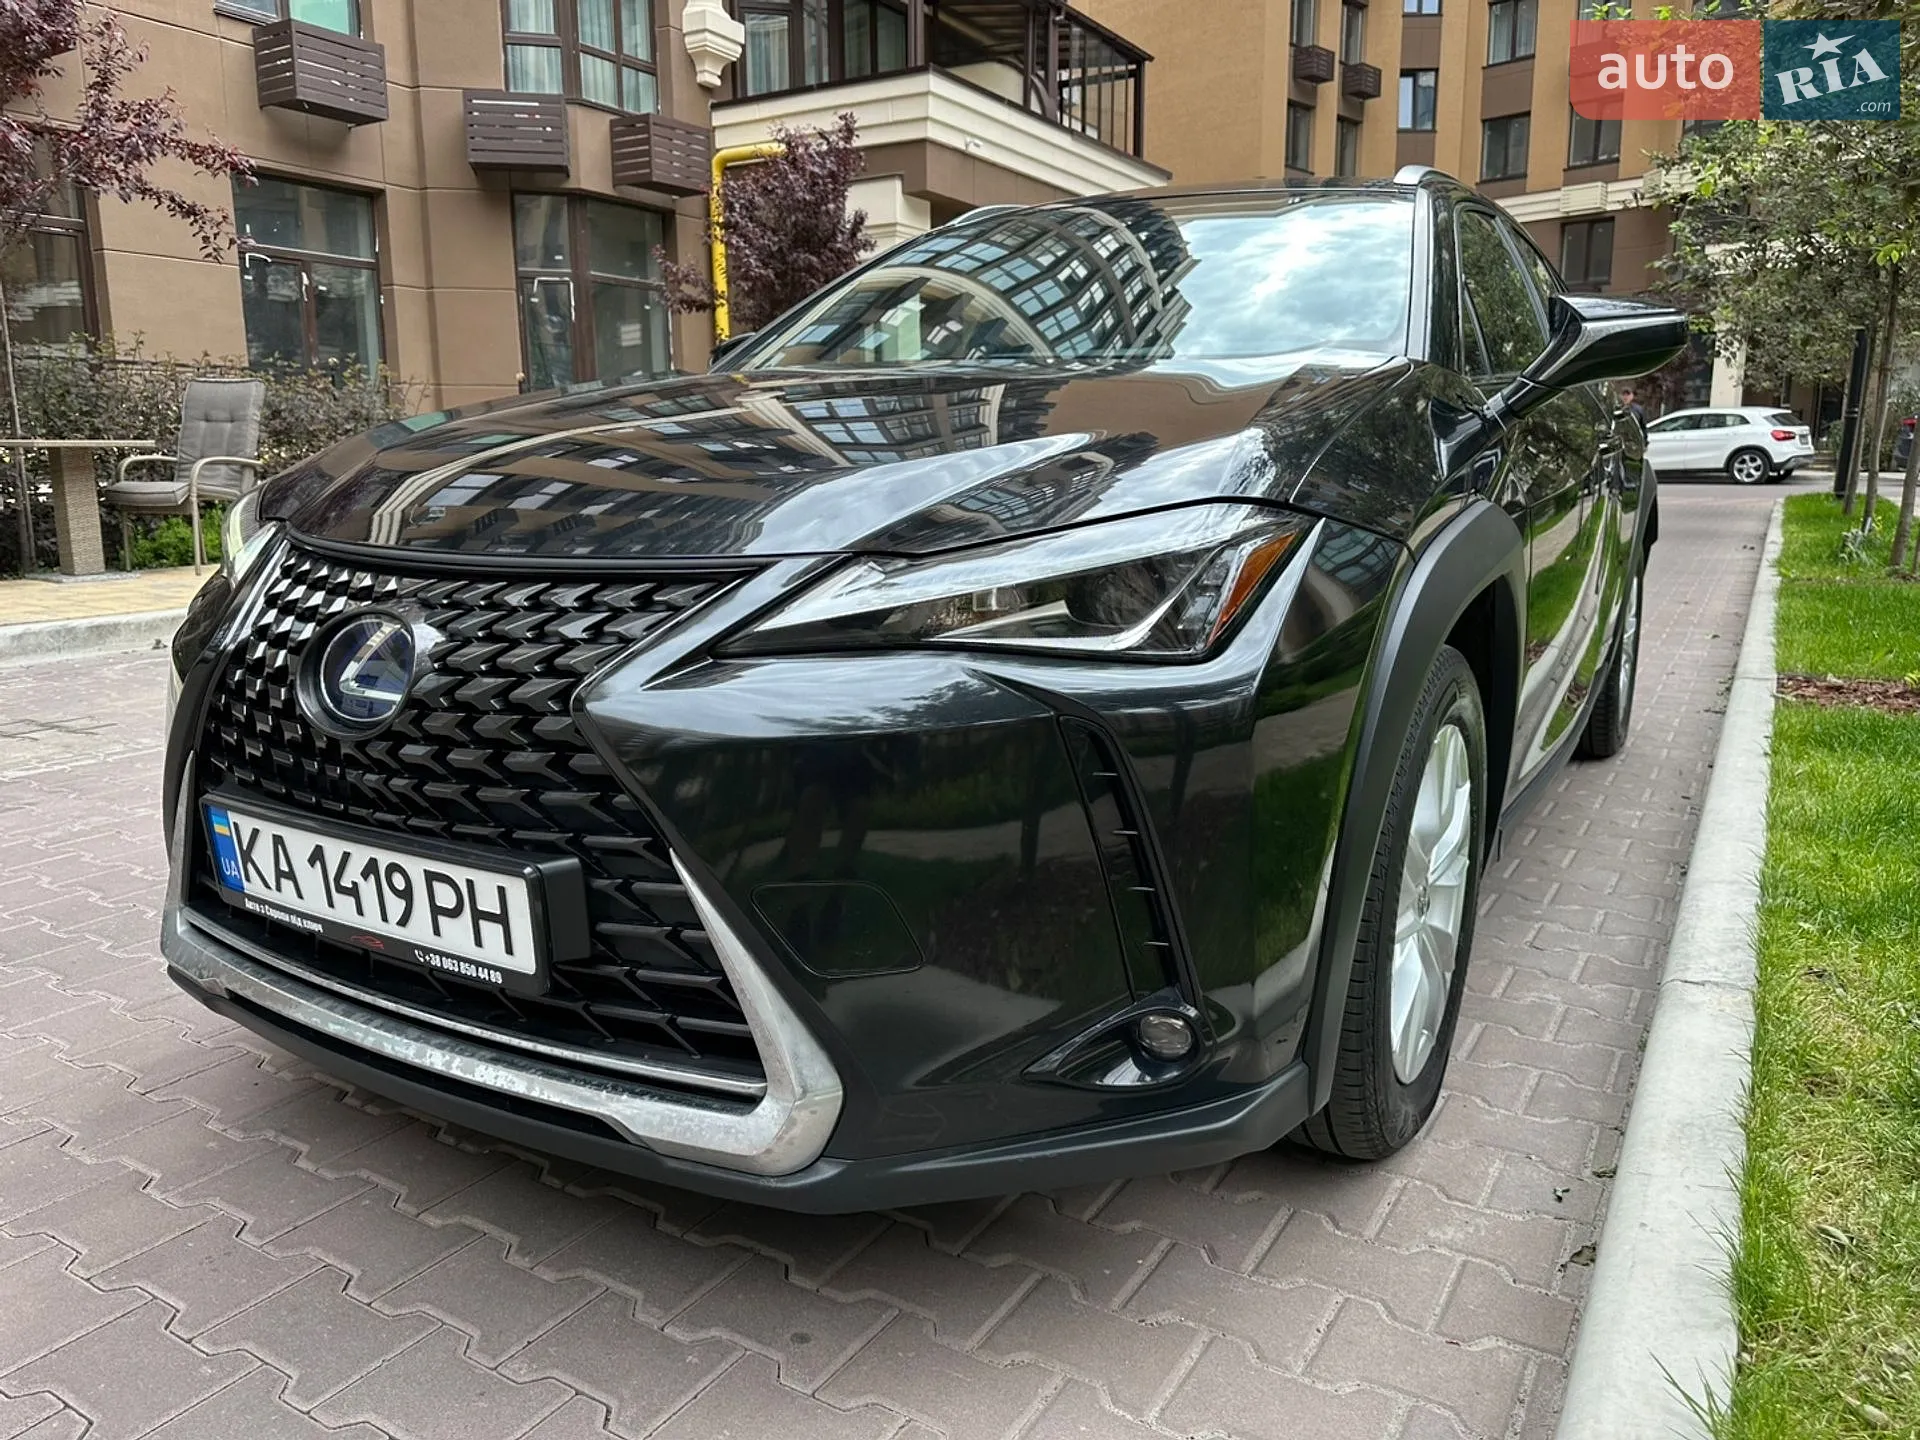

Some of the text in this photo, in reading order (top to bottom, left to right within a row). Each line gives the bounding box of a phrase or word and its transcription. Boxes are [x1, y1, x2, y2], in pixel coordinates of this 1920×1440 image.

[220, 857, 241, 879] UA
[233, 821, 514, 956] KA 1419 PH
[425, 953, 441, 967] +38
[442, 956, 459, 972] 063
